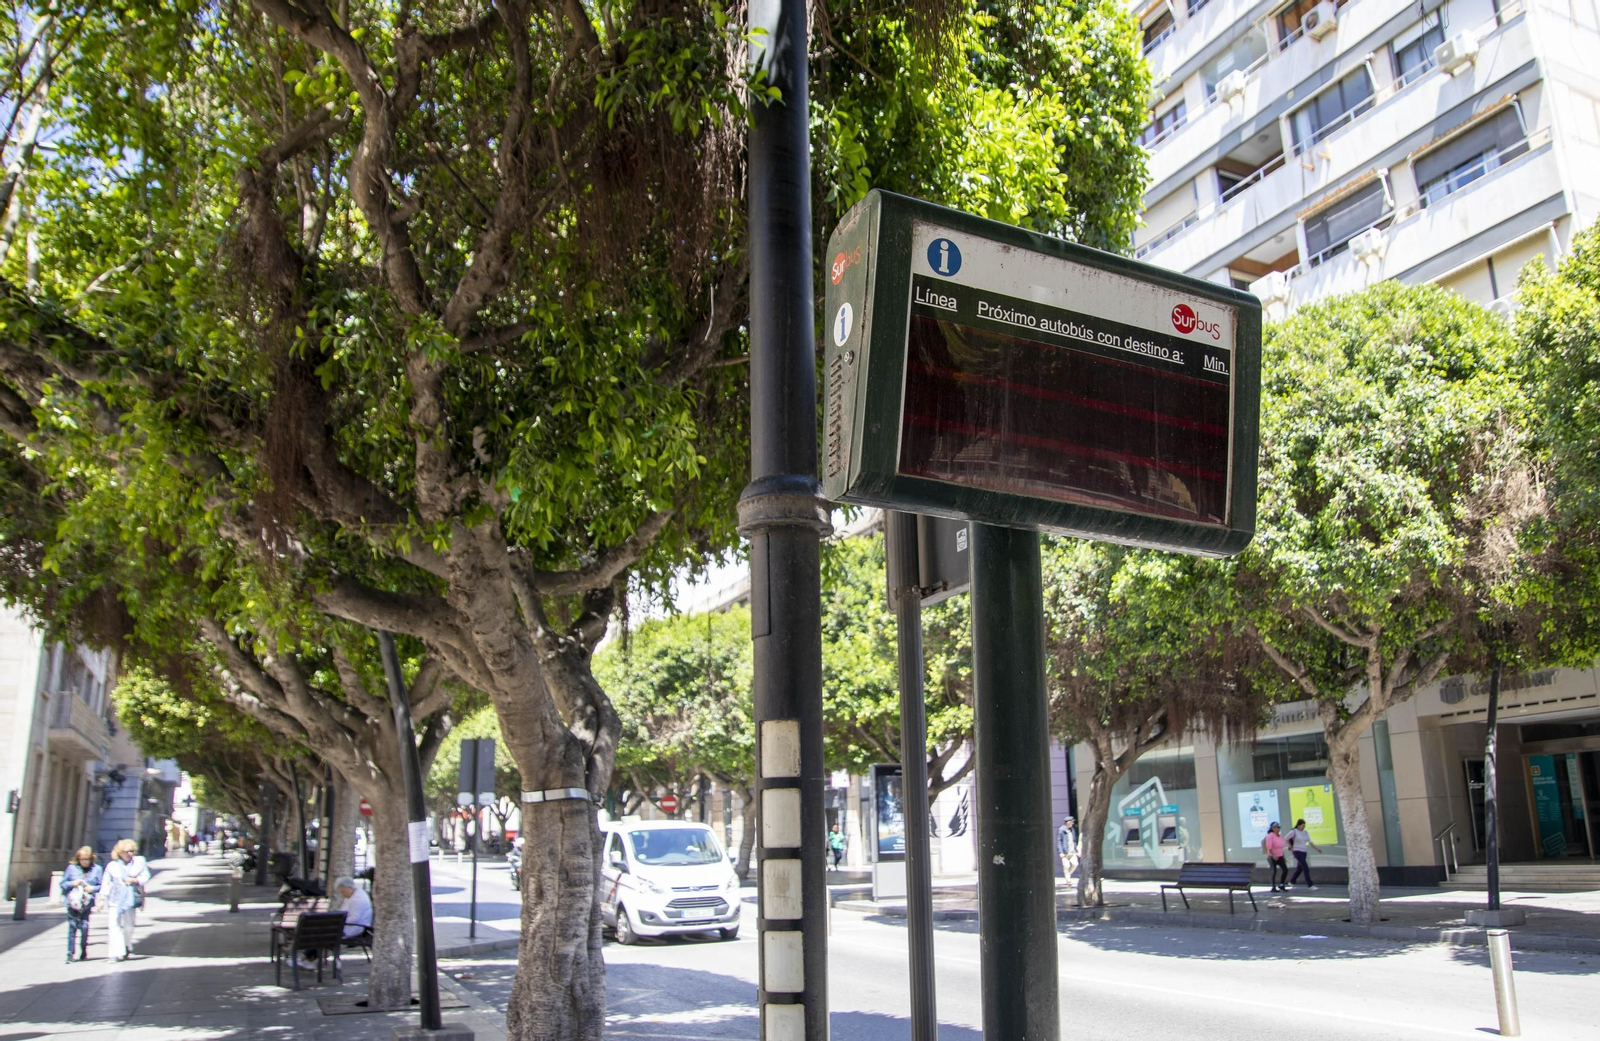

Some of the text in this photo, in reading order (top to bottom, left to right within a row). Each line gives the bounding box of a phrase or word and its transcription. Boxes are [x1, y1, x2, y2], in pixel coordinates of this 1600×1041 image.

[832, 246, 861, 280] Surbus
[915, 286, 957, 310] Línea
[977, 301, 1184, 362] Próximo autobús con destino a:
[1172, 307, 1221, 340] Surbus
[1204, 354, 1229, 373] Min.
